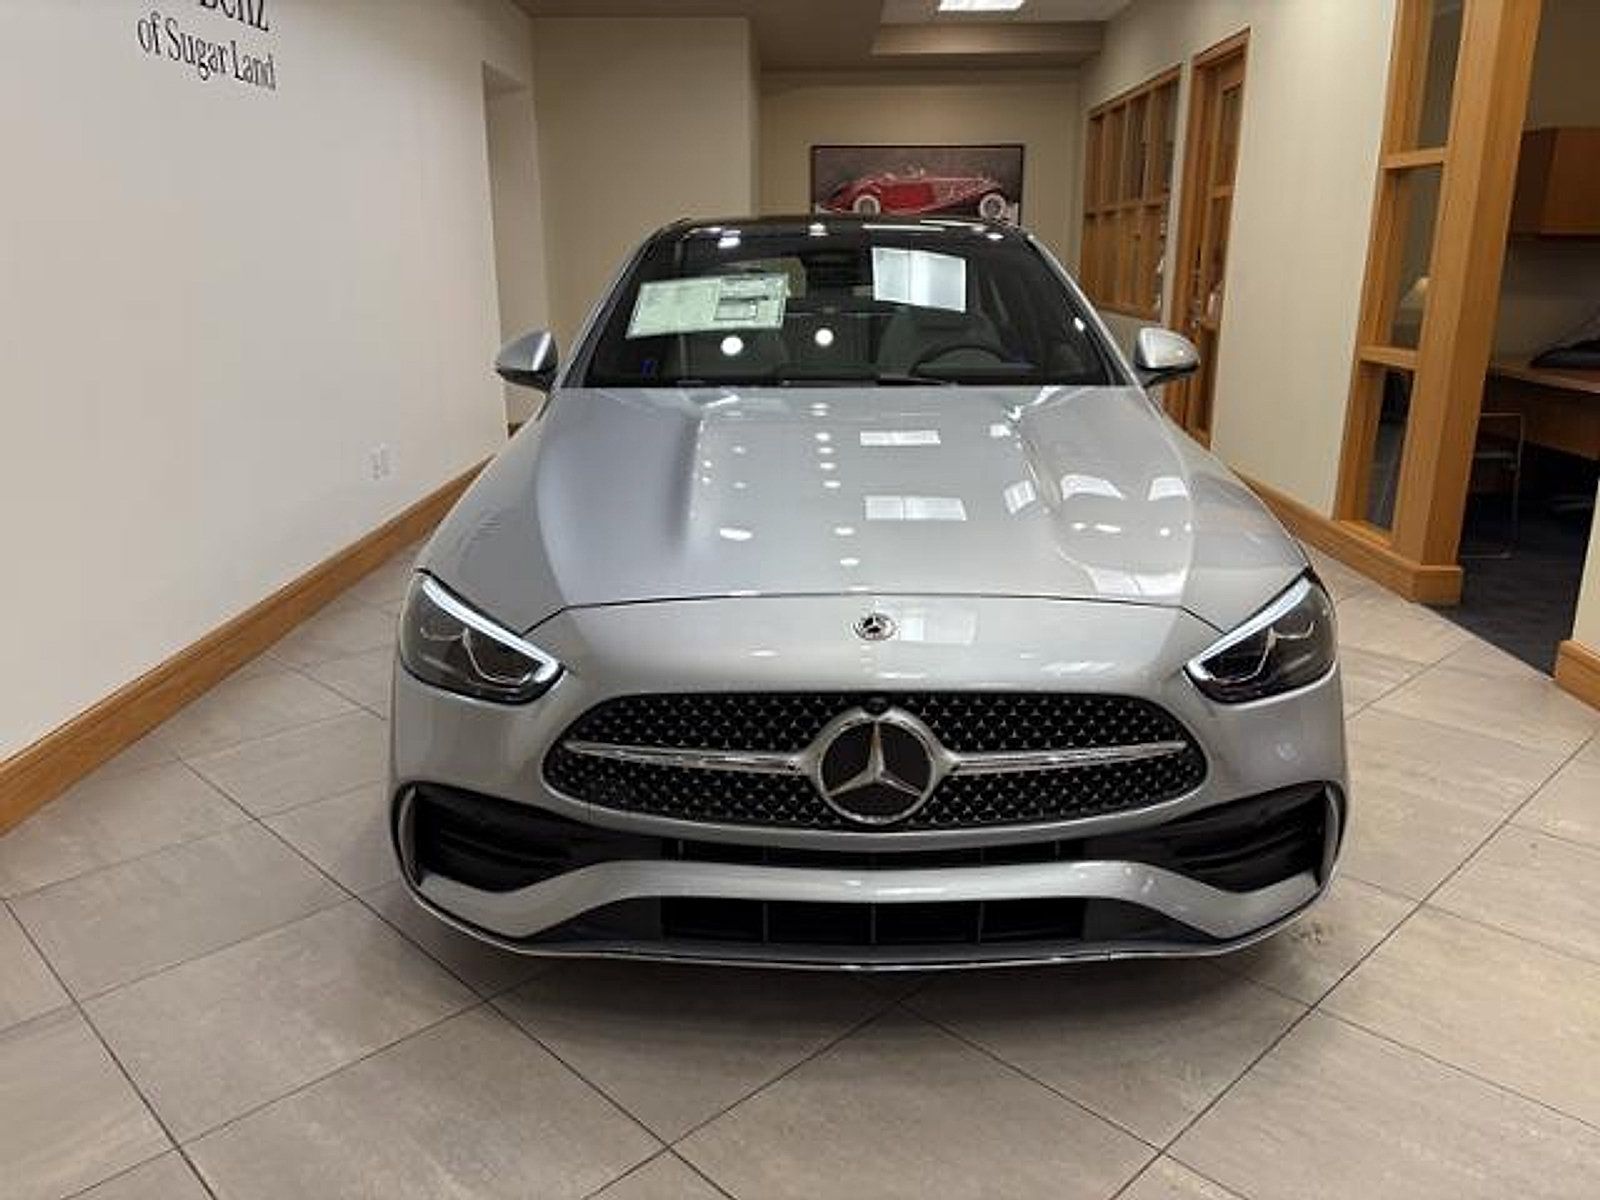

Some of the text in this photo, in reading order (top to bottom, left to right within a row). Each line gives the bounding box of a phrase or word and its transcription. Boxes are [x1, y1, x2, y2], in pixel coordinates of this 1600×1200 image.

[200, 0, 269, 32] enz
[137, 11, 276, 90] of Sugar Land
